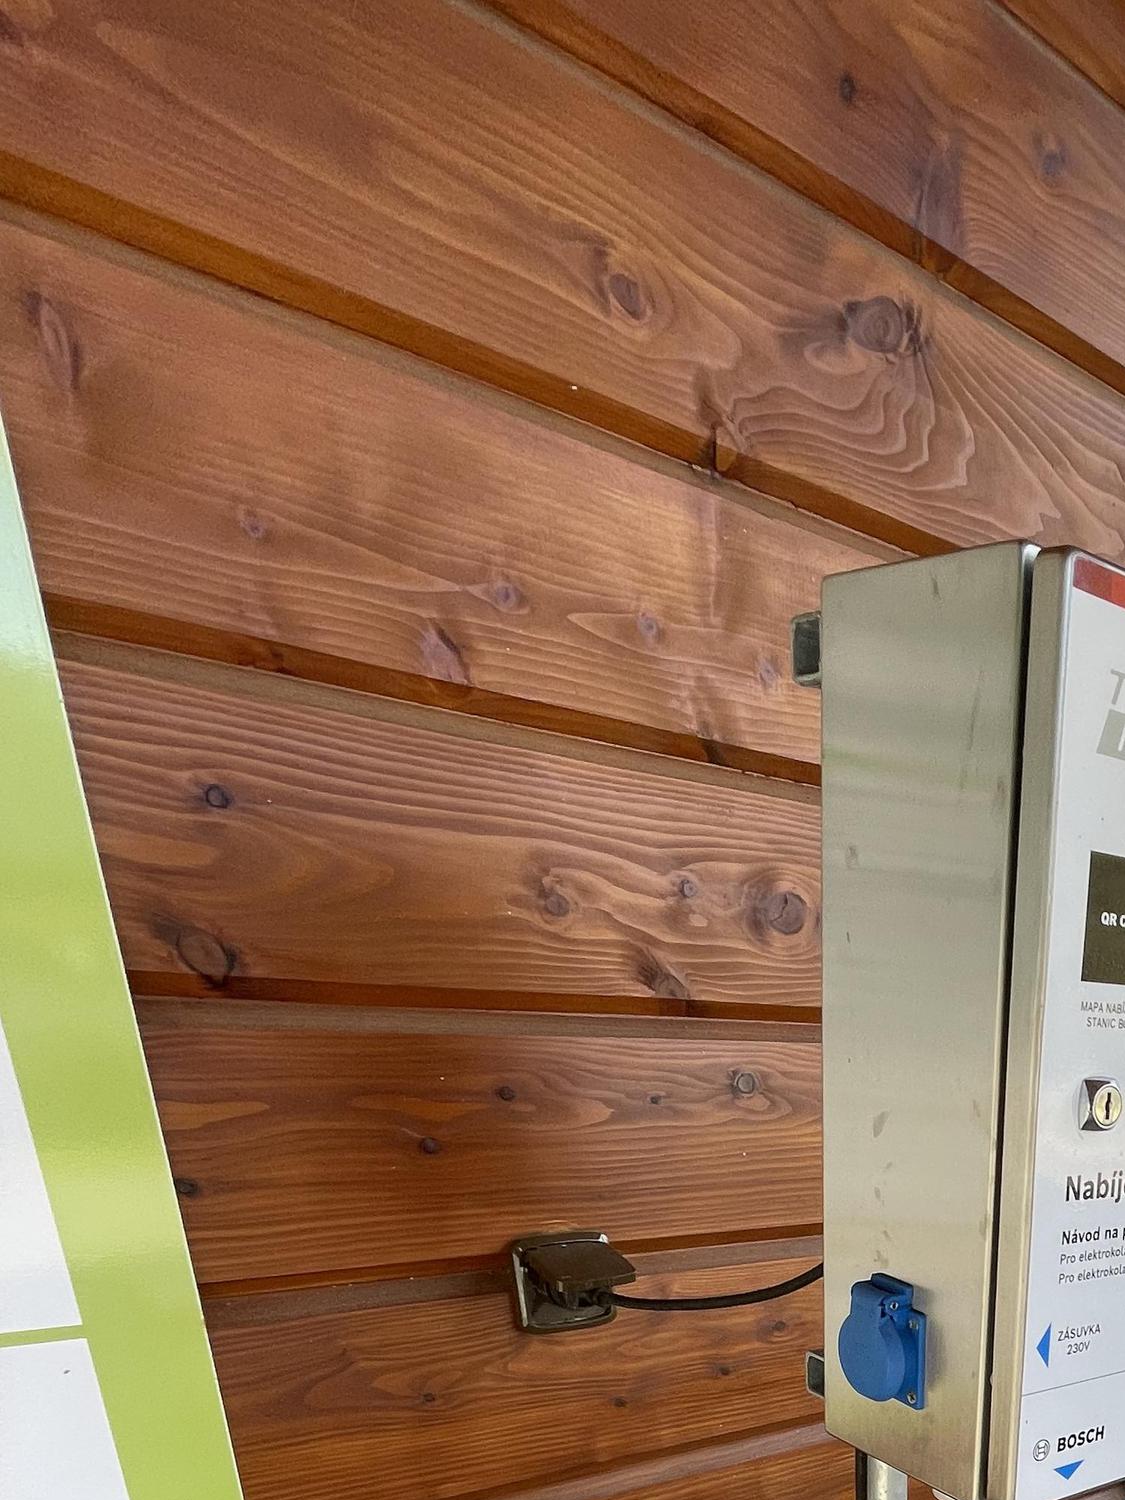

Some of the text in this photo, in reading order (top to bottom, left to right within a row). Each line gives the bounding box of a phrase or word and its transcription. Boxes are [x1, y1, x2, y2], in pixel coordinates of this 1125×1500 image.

[1100, 911, 1117, 928] QR
[1081, 1001, 1103, 1014] MAPA
[1086, 1017, 1116, 1029] STANIC
[1061, 1226, 1101, 1245] Návod
[1104, 1228, 1119, 1240] na
[1059, 1253, 1076, 1265] Pro
[1058, 1273, 1075, 1285] Pro
[1057, 1323, 1101, 1342] ZÁSUVKA
[1066, 1340, 1091, 1356] 230V
[1057, 1425, 1105, 1453] BOSCH
